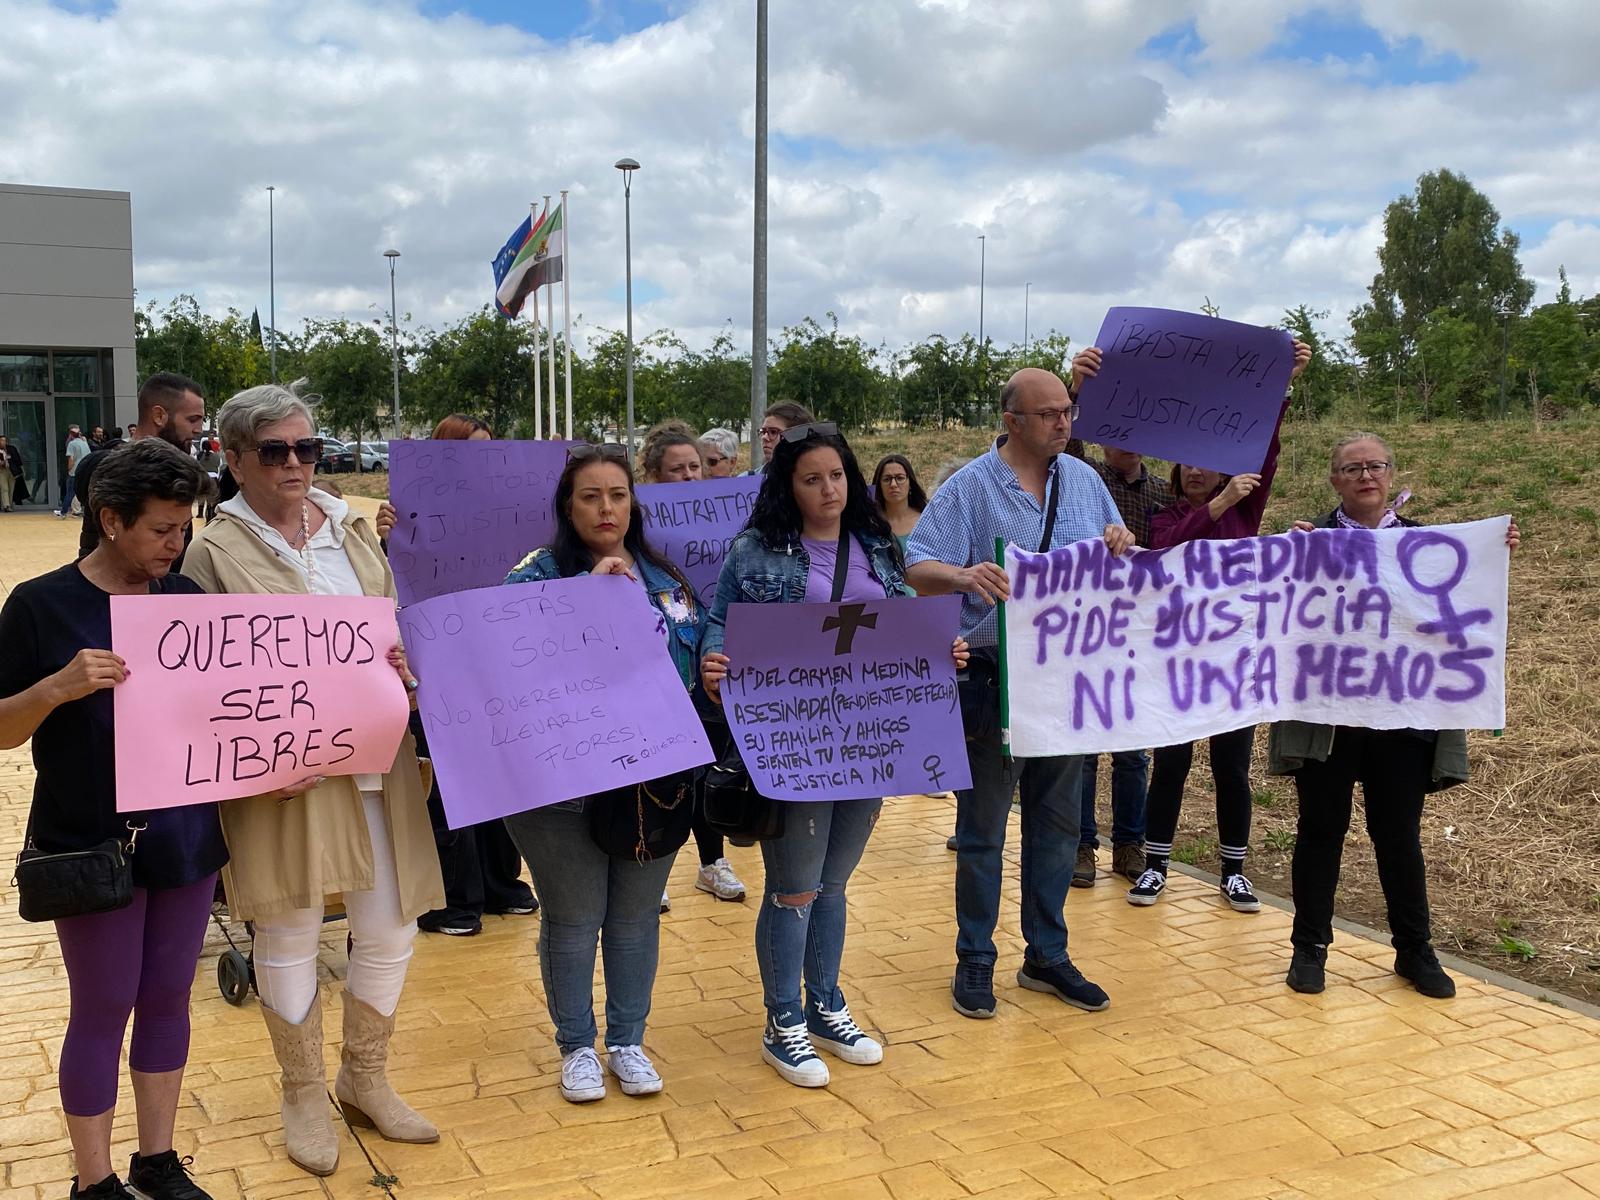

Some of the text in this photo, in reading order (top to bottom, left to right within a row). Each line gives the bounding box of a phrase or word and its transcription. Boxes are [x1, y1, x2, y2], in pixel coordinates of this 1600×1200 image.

[1109, 318, 1278, 389] ¡BASTA YA!
[392, 443, 462, 474] POR
[402, 469, 561, 499] POR TODA
[409, 497, 555, 545] ¡JUSTICI
[684, 537, 732, 569] BADA
[1183, 528, 1379, 591] MEDINA
[157, 613, 375, 673] QUEREMOS
[406, 608, 465, 651] NO
[510, 622, 620, 669] SOLA!
[1032, 596, 1137, 666] PIDE
[753, 667, 786, 690] DEL
[788, 662, 852, 686] CARMEN
[861, 656, 931, 685] MEDINA
[1071, 643, 1496, 731] NI UNA MENOS
[209, 679, 316, 722] SER
[427, 676, 608, 733] NO QUEREMOS
[733, 692, 832, 725] ASESINADA
[906, 687, 923, 705] DE
[490, 704, 607, 747] LLEVARLE
[534, 722, 648, 769] FLORES!
[743, 715, 911, 752] SU FAMILIA Y AMIGOS
[184, 726, 355, 787] LIBRES
[610, 753, 640, 771] TE
[756, 748, 814, 771] SIENTEN
[814, 745, 834, 766] TU
[770, 759, 895, 792] LA JUSTICIA NO
